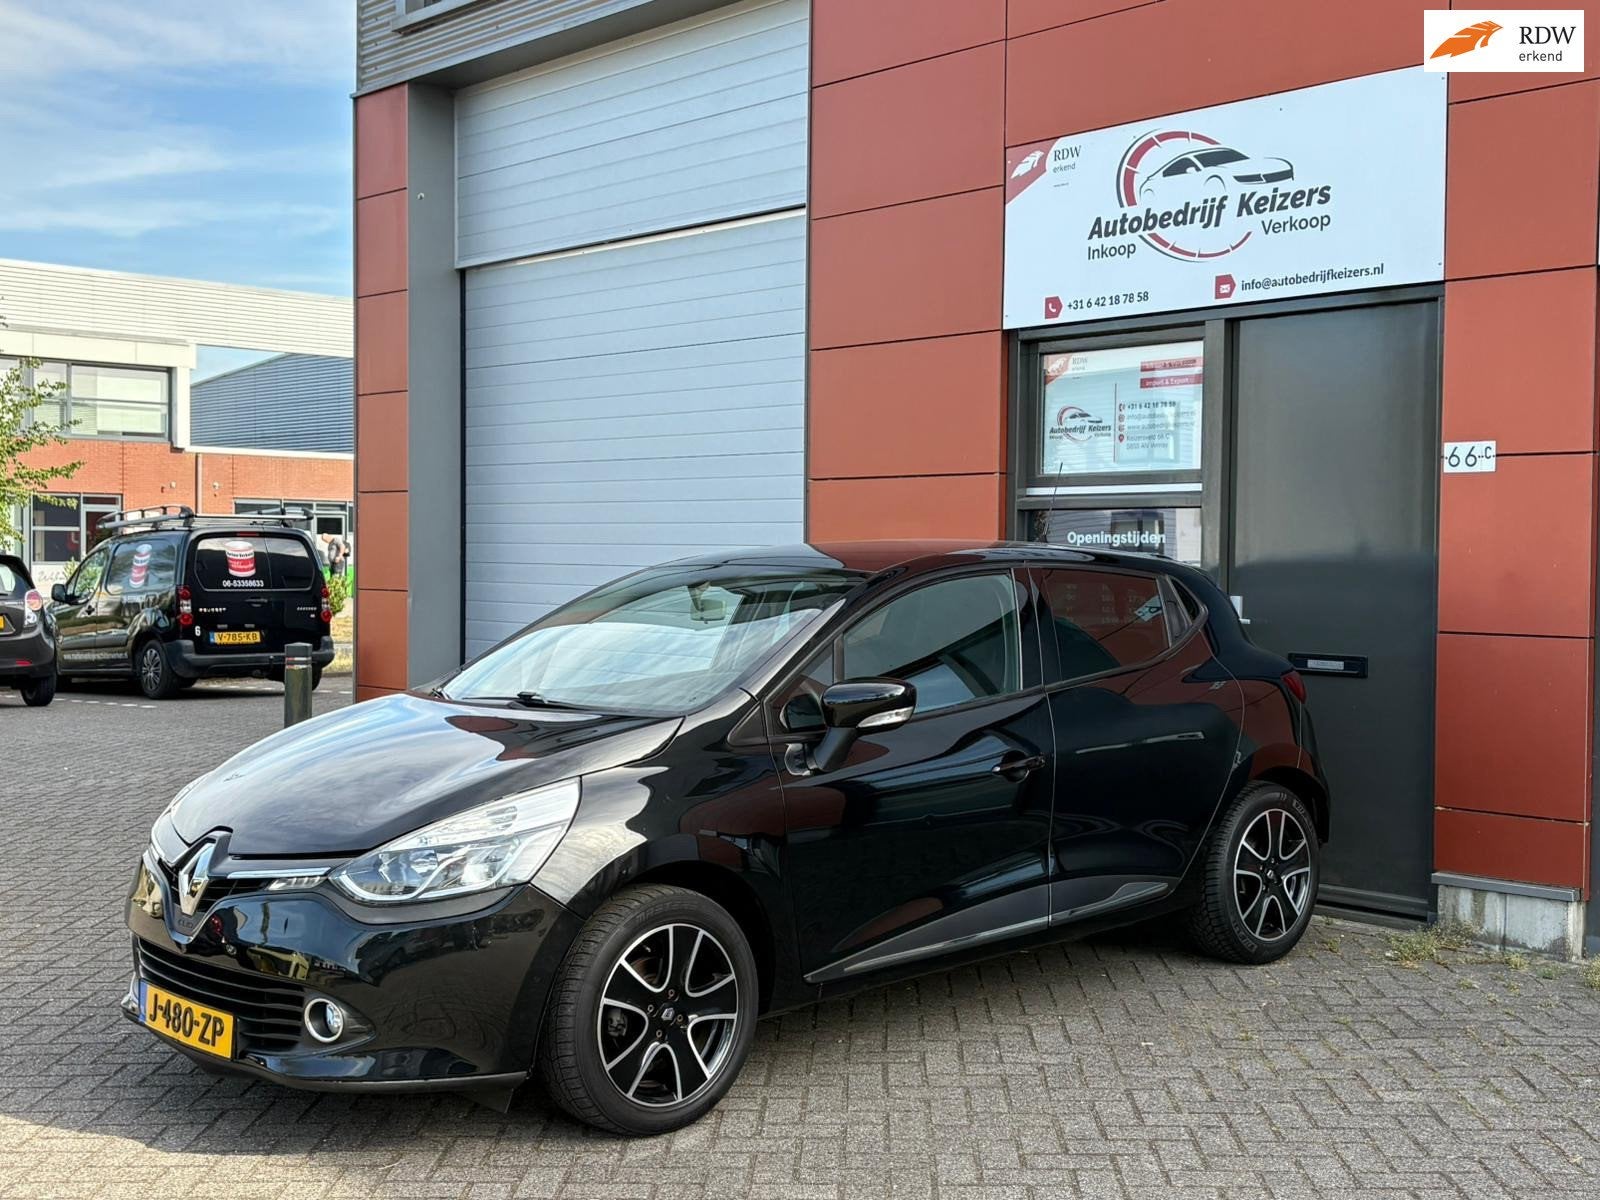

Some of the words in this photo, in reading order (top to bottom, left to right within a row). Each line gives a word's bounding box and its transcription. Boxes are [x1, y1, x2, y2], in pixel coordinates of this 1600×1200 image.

[1054, 145, 1082, 162] RDW
[1053, 163, 1076, 174] erkend
[1088, 196, 1228, 240] Autobedrijf
[1236, 185, 1332, 217] Keizers
[1261, 214, 1331, 236] Verkoop
[1088, 243, 1136, 260] Inkoop
[1241, 263, 1385, 291] info@autobedrijfkeizers.nl
[1068, 299, 1084, 310] +31
[1086, 298, 1093, 308] 6
[1094, 296, 1106, 307] 42
[1109, 294, 1120, 305] 18
[1123, 293, 1134, 304] 78
[1137, 291, 1149, 302] 58
[1067, 531, 1166, 547] Openingstijden
[216, 632, 258, 641] V-785-KB
[149, 993, 225, 1047] J-480-ZP
